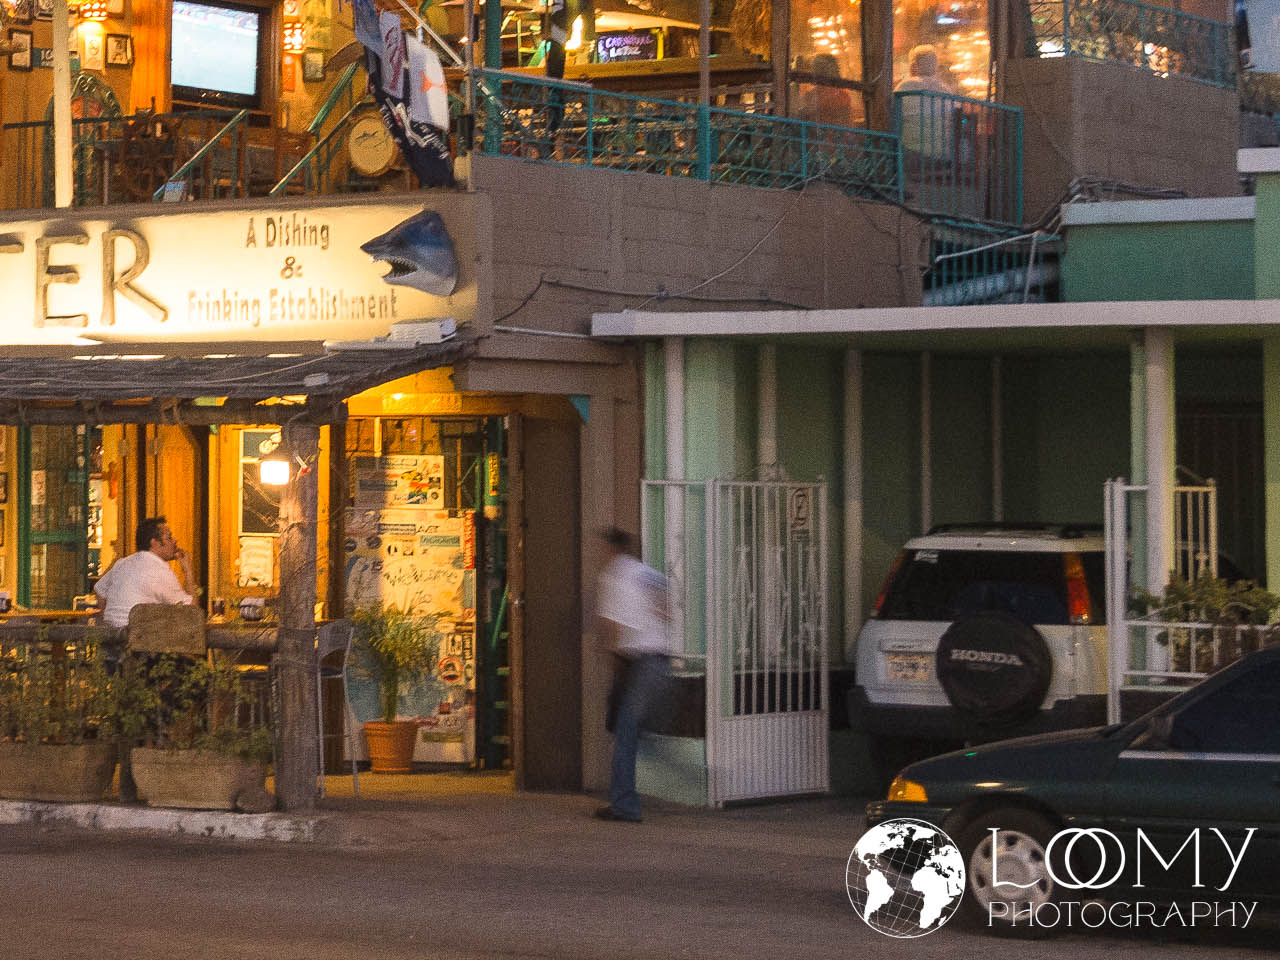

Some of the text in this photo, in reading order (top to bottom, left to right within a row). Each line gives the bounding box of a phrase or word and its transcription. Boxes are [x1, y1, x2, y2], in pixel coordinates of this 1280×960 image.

[245, 213, 330, 250] A Dishing
[280, 256, 303, 279] &
[268, 287, 398, 321] Establishment
[950, 648, 1023, 666] HONDA
